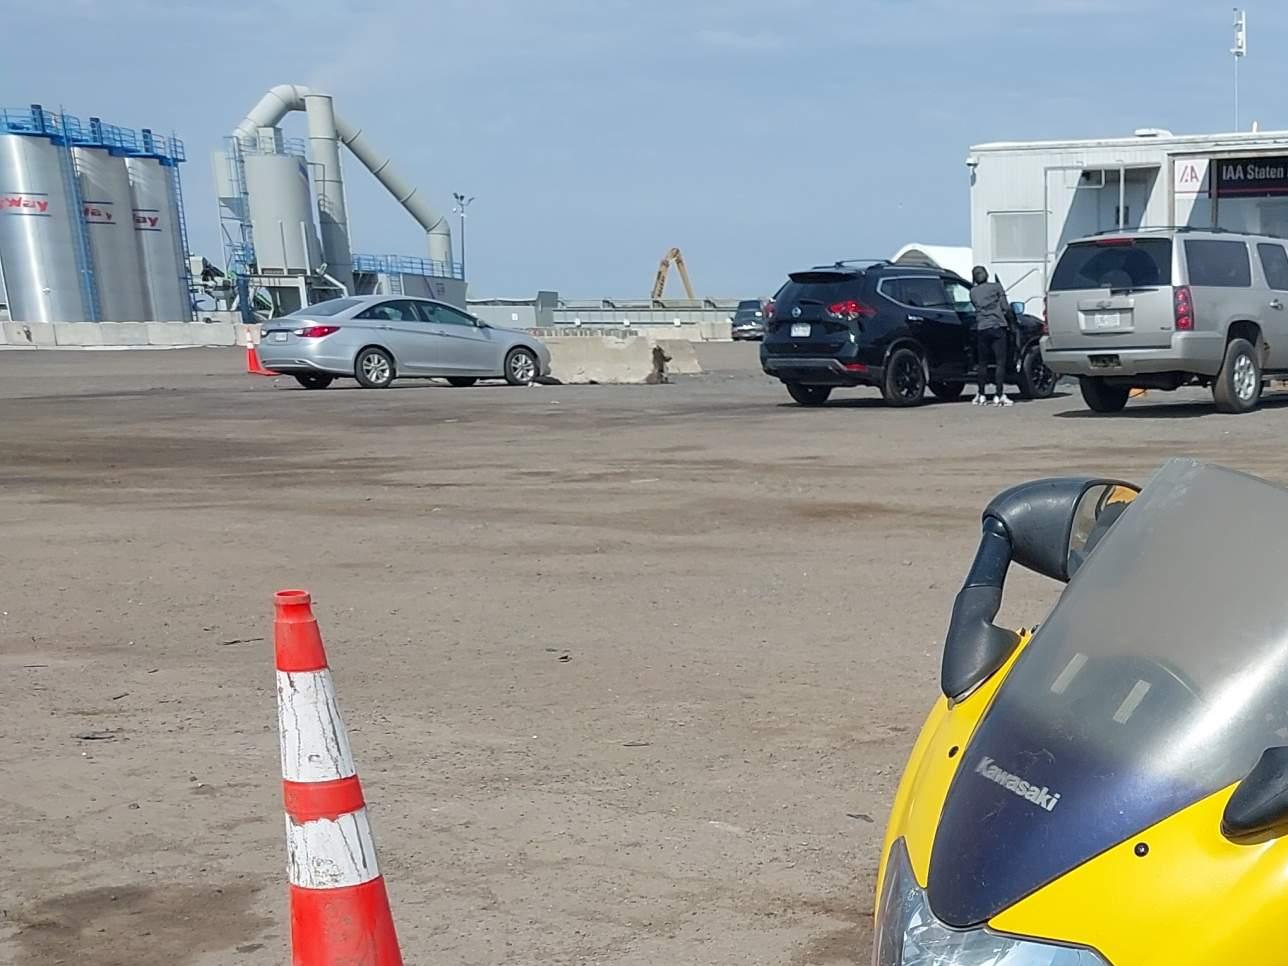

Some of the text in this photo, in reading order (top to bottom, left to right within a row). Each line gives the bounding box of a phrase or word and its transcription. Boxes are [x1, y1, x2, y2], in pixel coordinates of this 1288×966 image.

[1223, 165, 1244, 180] IAA
[1247, 164, 1284, 179] Staten
[0, 197, 48, 212] Way
[975, 756, 1061, 811] Kawasaki
